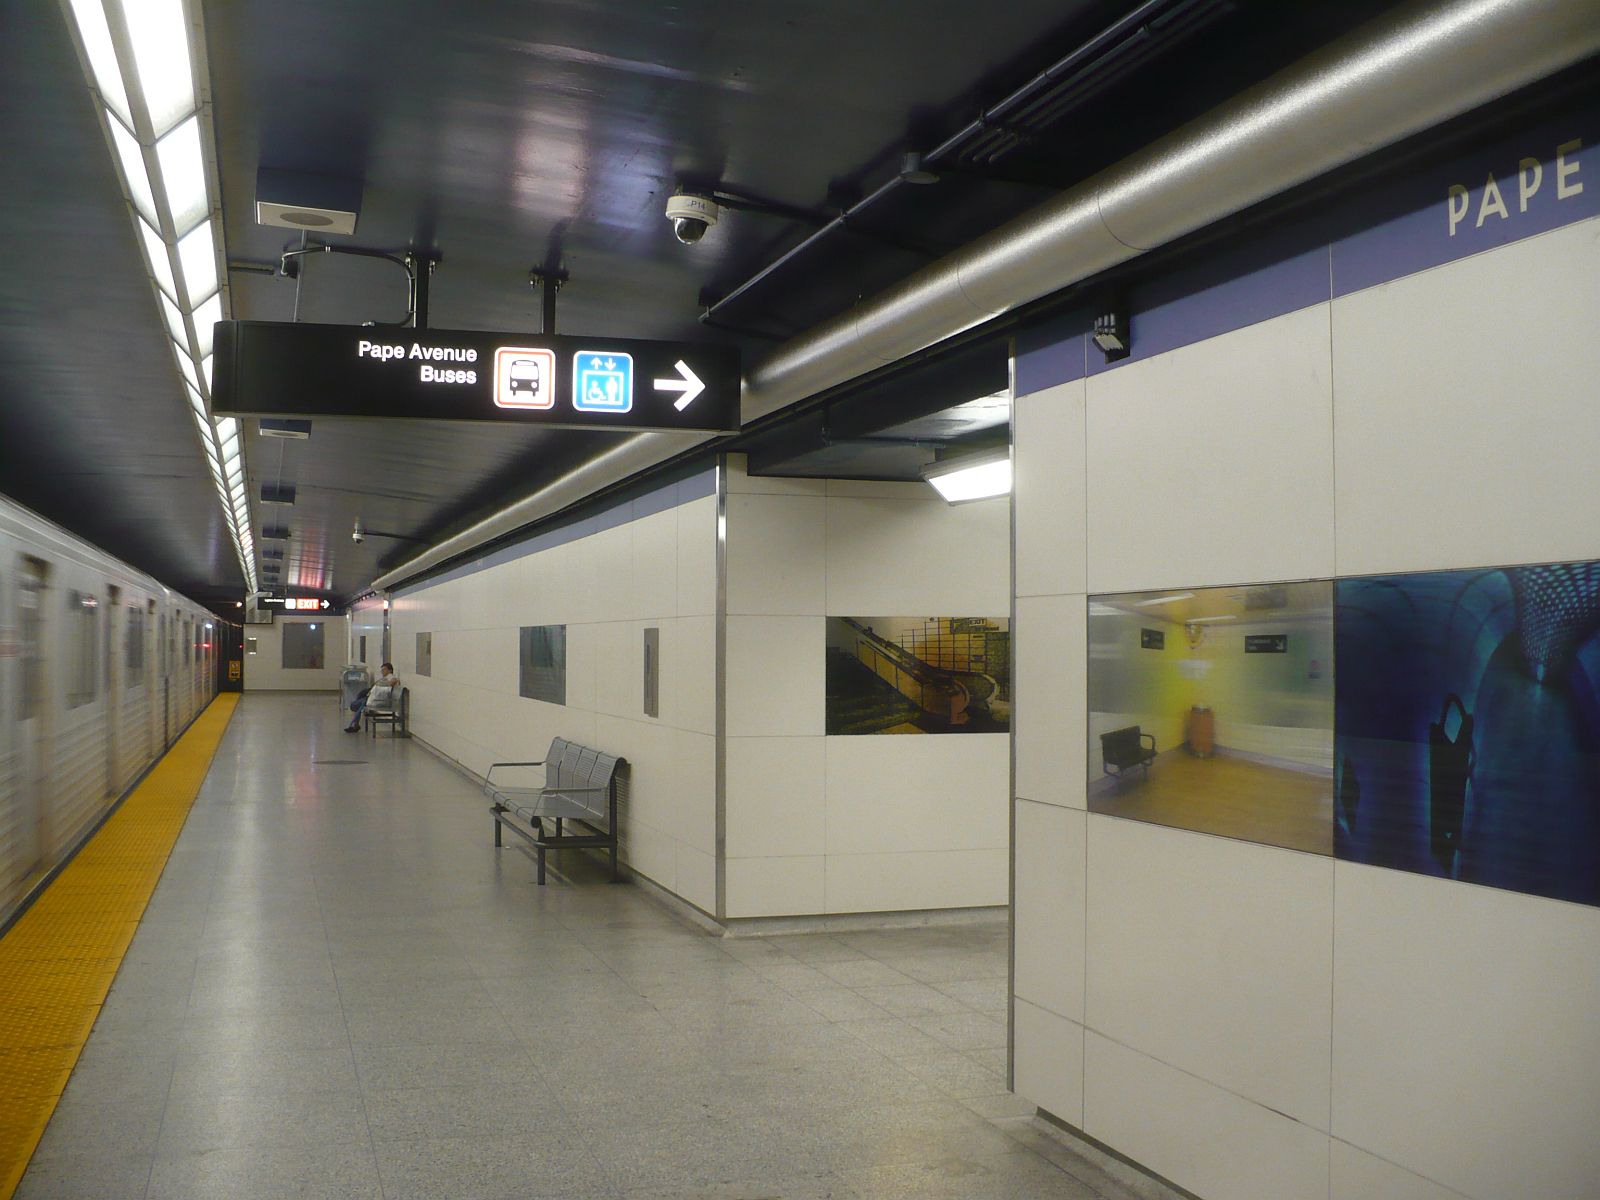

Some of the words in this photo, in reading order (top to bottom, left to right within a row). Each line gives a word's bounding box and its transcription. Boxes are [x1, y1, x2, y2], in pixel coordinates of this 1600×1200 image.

[1448, 138, 1583, 236] PAPE
[358, 340, 405, 362] Pape
[408, 342, 478, 362] Avenue
[420, 365, 477, 384] Buses
[297, 599, 319, 609] EXIT
